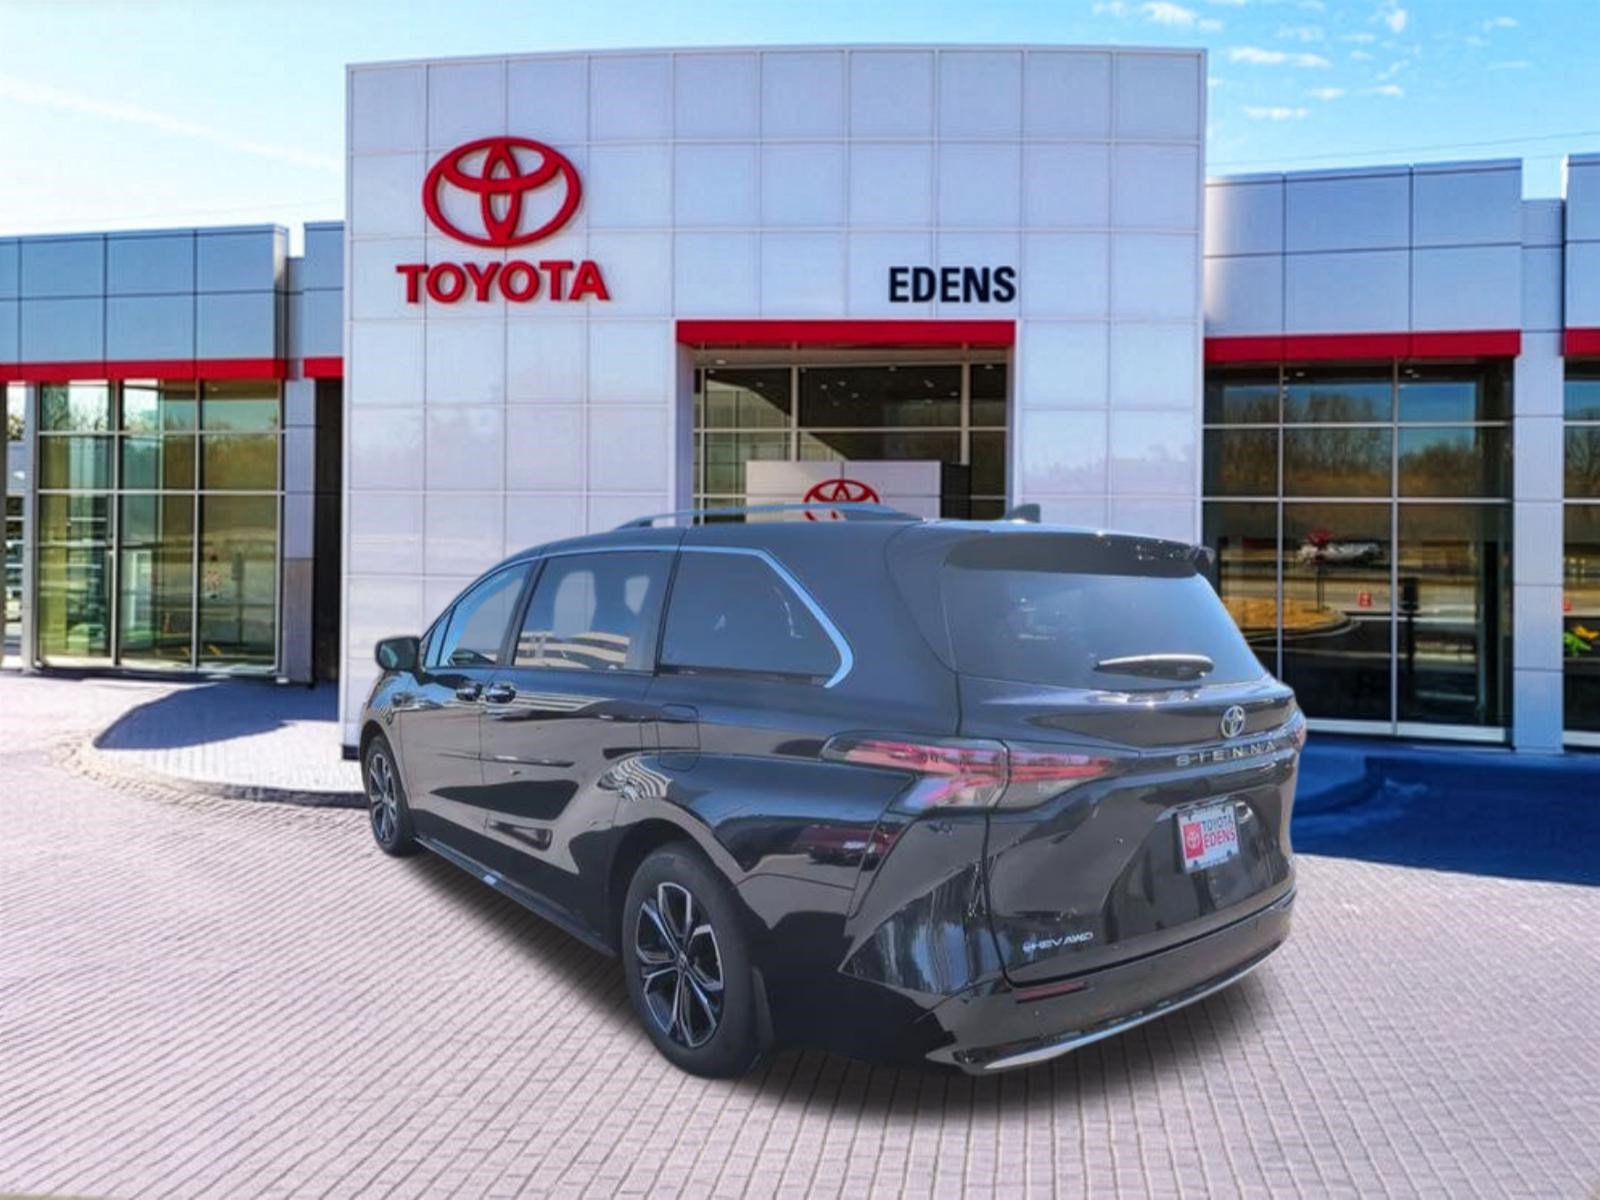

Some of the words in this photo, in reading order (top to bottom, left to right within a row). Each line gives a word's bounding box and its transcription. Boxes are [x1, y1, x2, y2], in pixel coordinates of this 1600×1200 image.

[396, 260, 610, 304] TOYOTA
[889, 266, 1017, 303] EDENS
[1176, 740, 1276, 767] SIENNA
[1202, 815, 1234, 833] TOYOTA
[1204, 829, 1236, 849] EDENS
